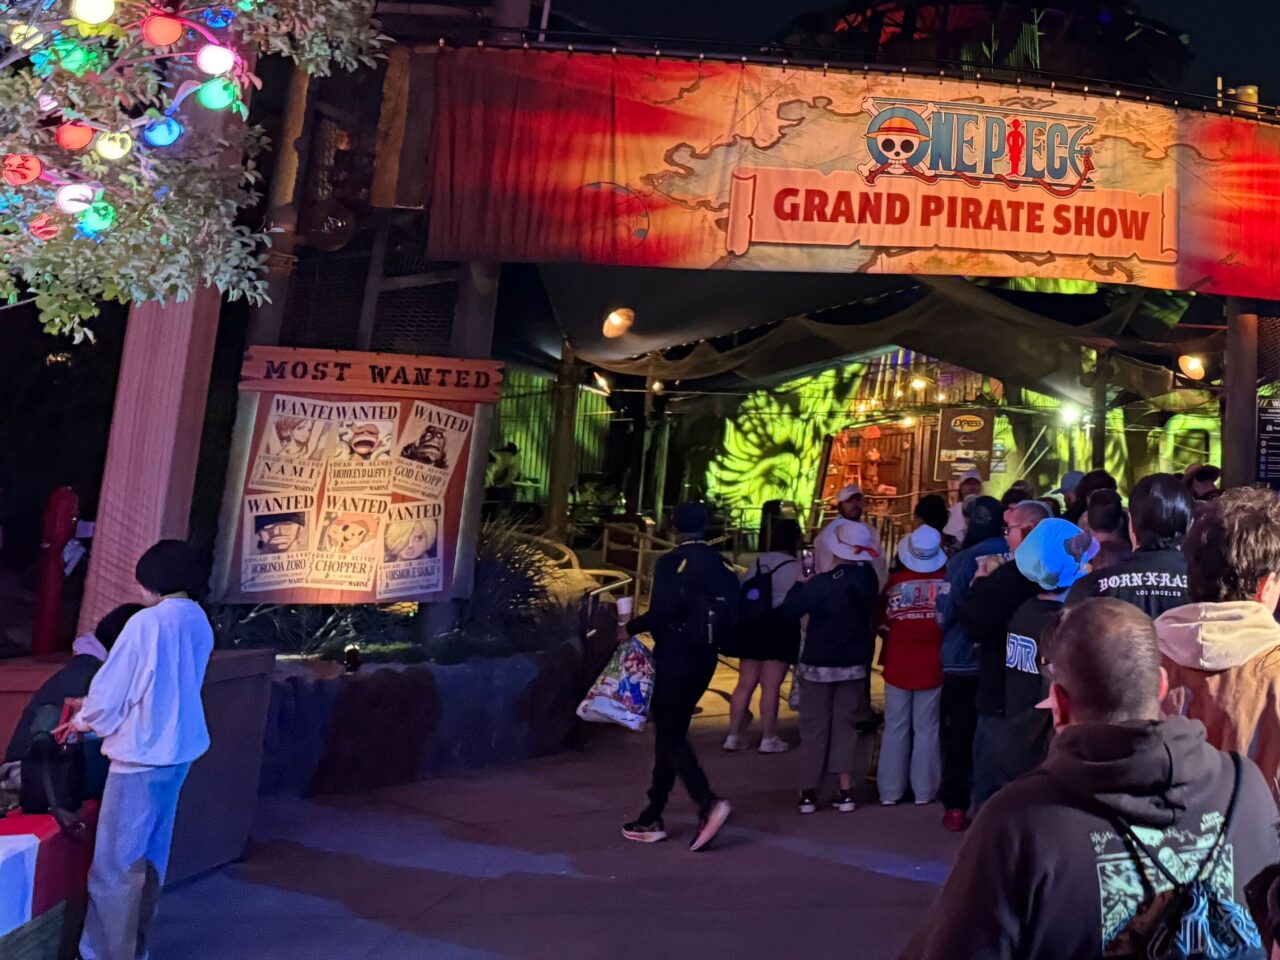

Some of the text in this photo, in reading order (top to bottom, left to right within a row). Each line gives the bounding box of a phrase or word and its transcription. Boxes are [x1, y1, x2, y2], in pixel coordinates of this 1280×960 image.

[863, 106, 1095, 183] ONE PIECE
[773, 187, 1151, 241] GRAND PIRATE SHOW
[264, 360, 491, 388] MOST WANTED
[337, 405, 398, 420] WANTED
[414, 404, 469, 433] WANTED
[263, 461, 315, 479] NAMI
[394, 465, 414, 479] GOD
[248, 494, 315, 513] WANTED
[327, 494, 388, 515] WANTED
[286, 559, 306, 570] ZORO
[315, 560, 367, 574] CHOPPER
[1006, 632, 1040, 675] DTR
